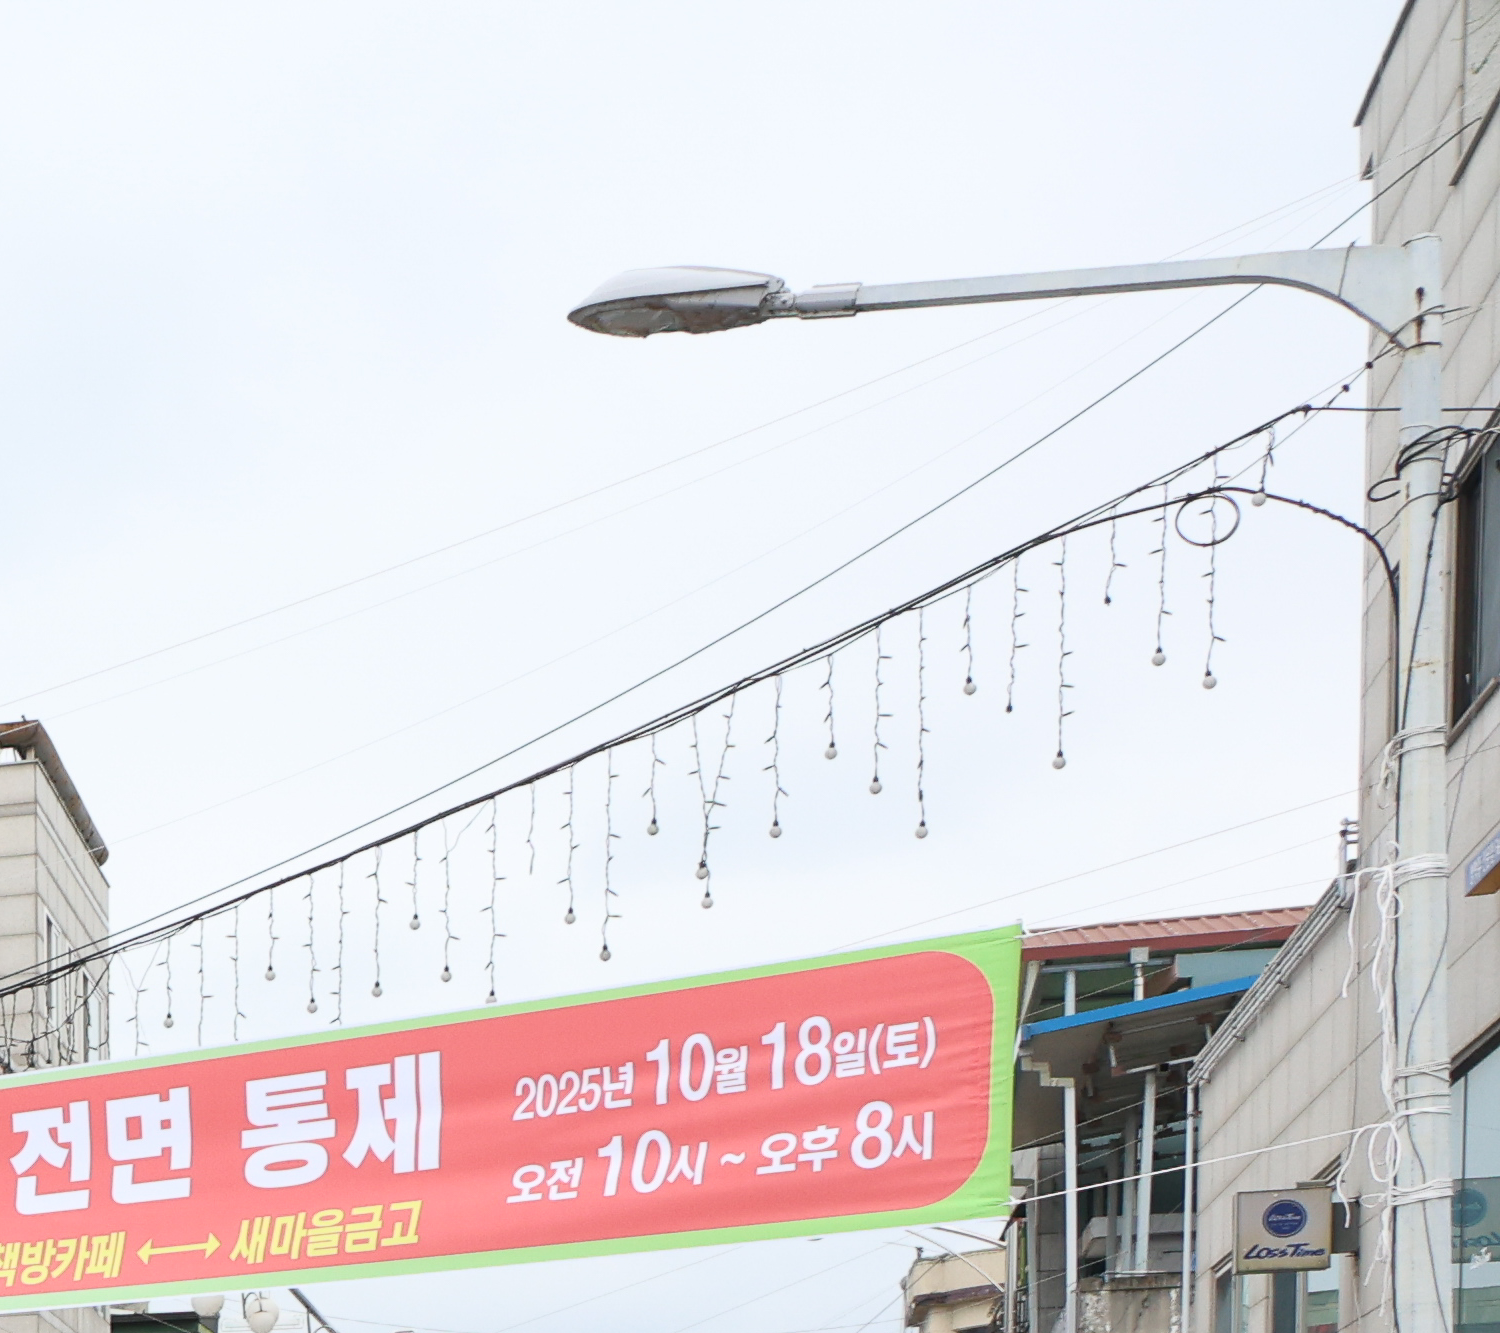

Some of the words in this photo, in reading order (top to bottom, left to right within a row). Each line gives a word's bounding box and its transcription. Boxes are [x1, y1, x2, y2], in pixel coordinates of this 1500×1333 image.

[513, 1064, 634, 1123] 2025년
[644, 1033, 752, 1108] 10월
[759, 1016, 938, 1092] 18일(토)
[8, 1090, 197, 1213] 전면
[240, 1050, 446, 1187] 통제
[506, 1152, 583, 1206] 오전
[595, 1130, 709, 1200] 10시
[756, 1124, 838, 1180] 오후
[850, 1100, 937, 1172] 8시
[228, 1200, 421, 1266] 새마을금고
